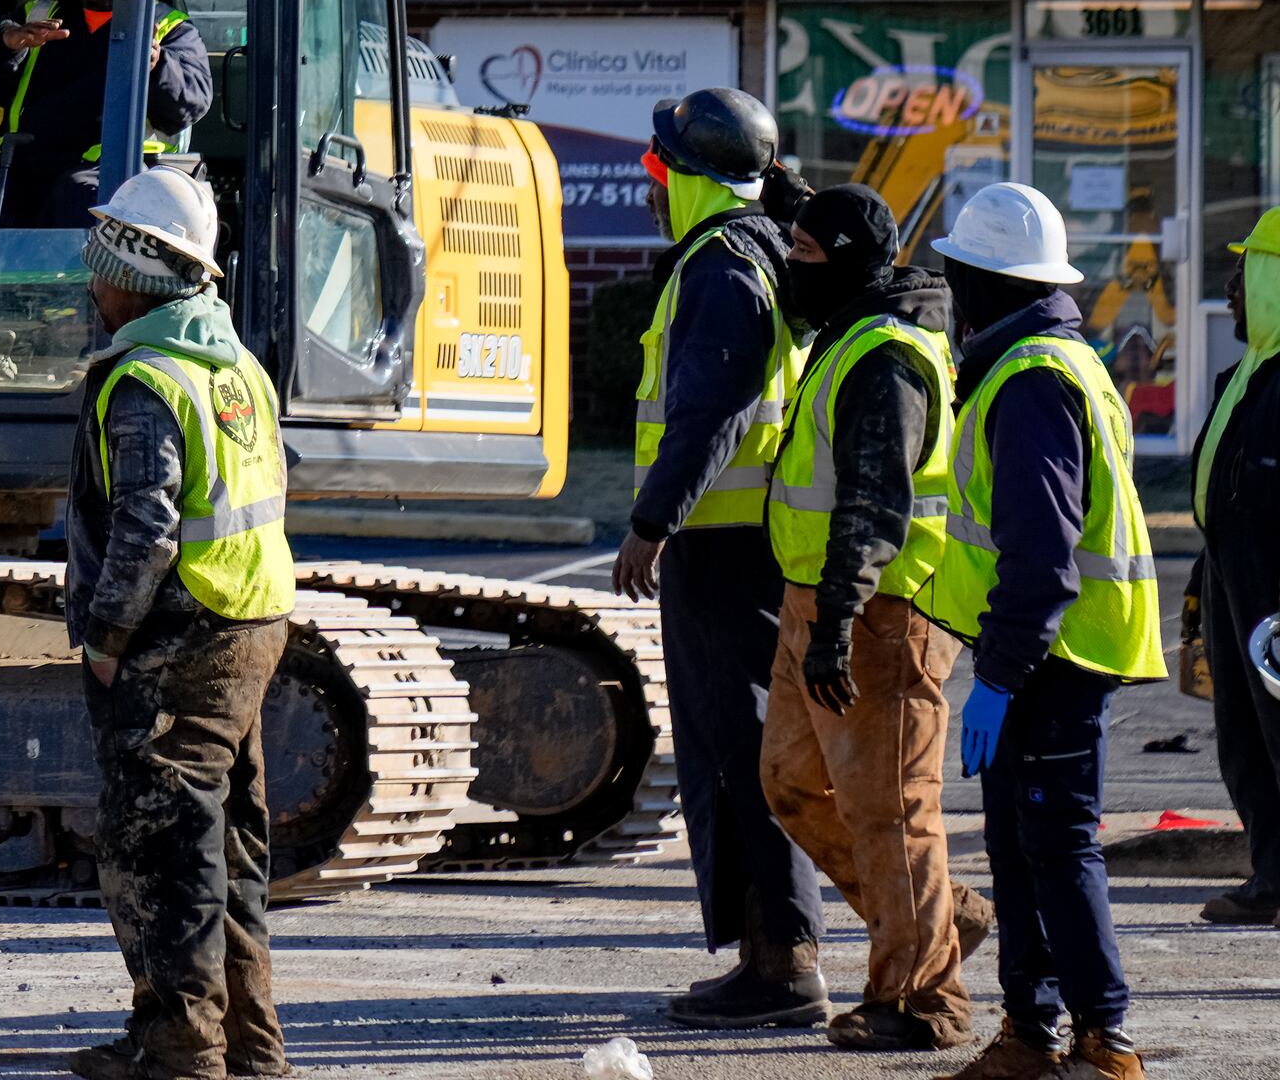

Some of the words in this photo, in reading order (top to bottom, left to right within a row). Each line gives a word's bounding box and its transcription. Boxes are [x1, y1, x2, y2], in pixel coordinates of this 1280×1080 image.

[1081, 8, 1142, 35] 3661
[632, 49, 687, 71] Vital
[842, 77, 967, 127] OPEN
